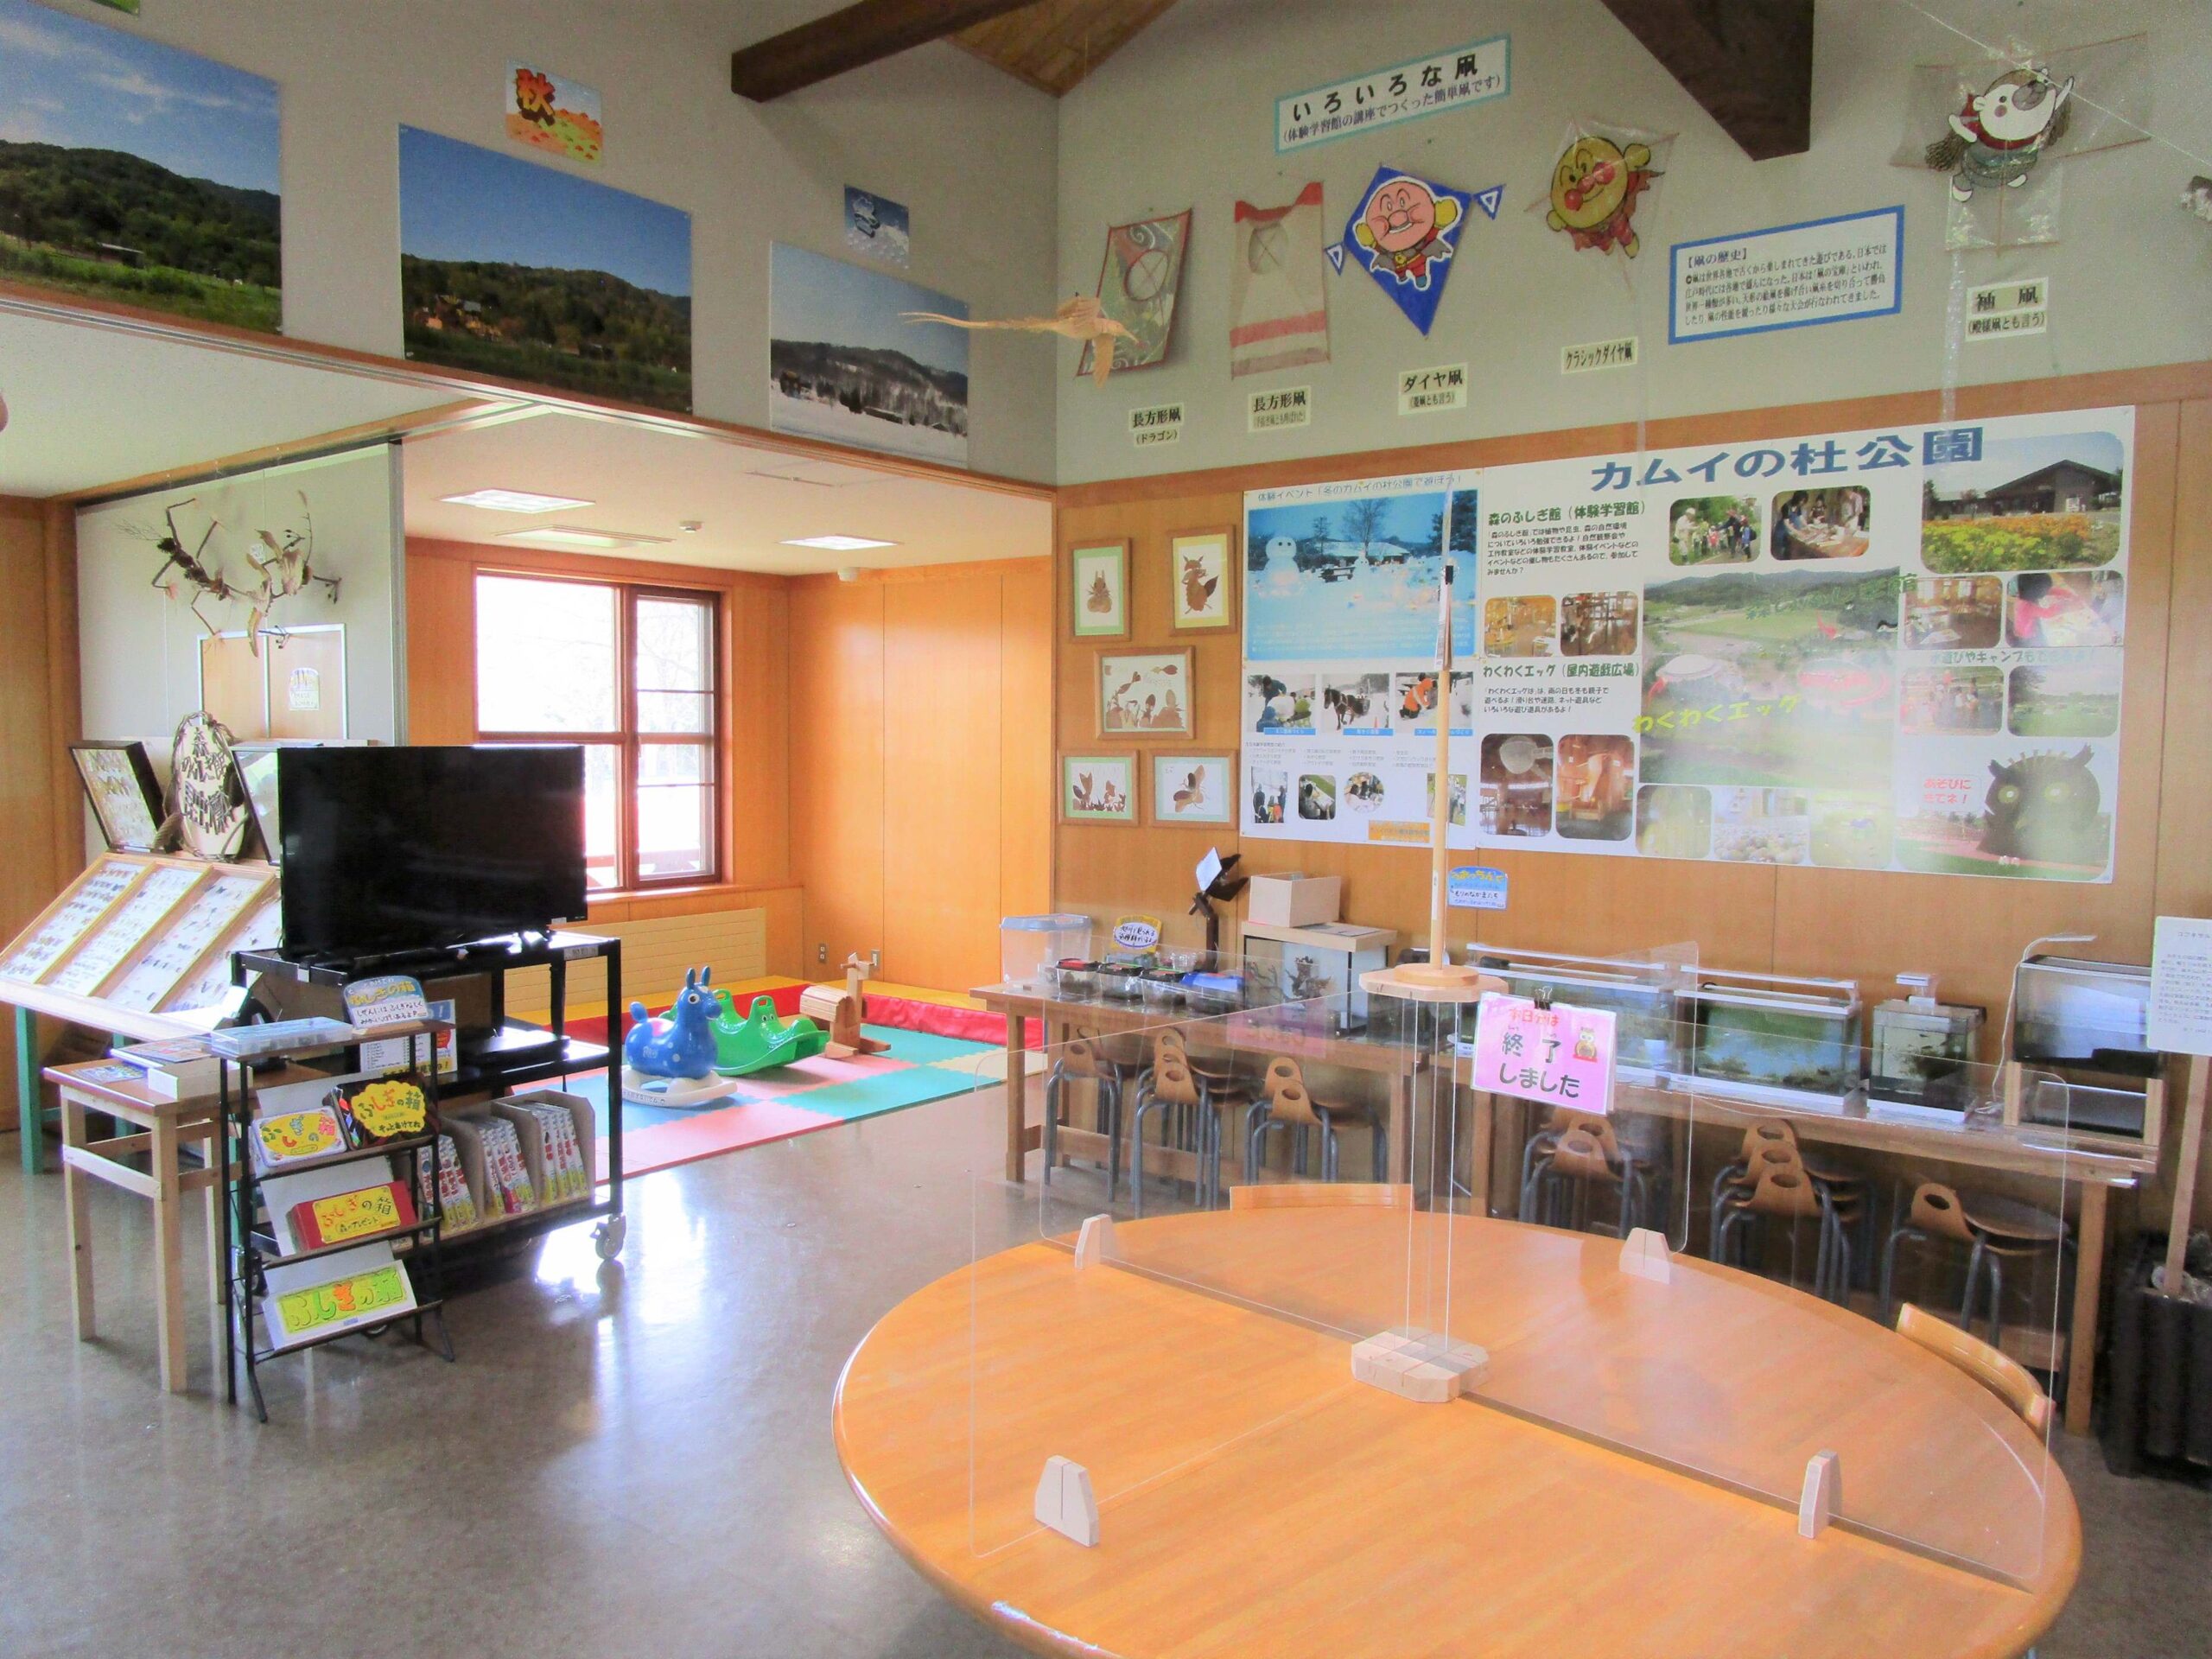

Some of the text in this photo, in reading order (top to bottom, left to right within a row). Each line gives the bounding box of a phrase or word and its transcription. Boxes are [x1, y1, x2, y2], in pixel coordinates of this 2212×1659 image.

[1294, 53, 1478, 122] いろいろな凧
[1566, 341, 1634, 371] クラシックダイヤ凧
[1403, 369, 1464, 393] ダイヤ凧
[1253, 391, 1306, 413] 長方形凧
[1133, 407, 1181, 429] 長方形凧
[1591, 427, 1984, 492] カムイの杜公園
[1488, 499, 1646, 526] 森のふしぎ館（体験学習館）
[1483, 663, 1640, 677] わくわくエッグ（屋内遊戯広場）
[1632, 693, 1802, 734] わくわくエッグ
[1503, 1031, 1561, 1064] 終了
[1499, 1063, 1580, 1098] しました
[321, 1194, 392, 1228] ふしぎの箱
